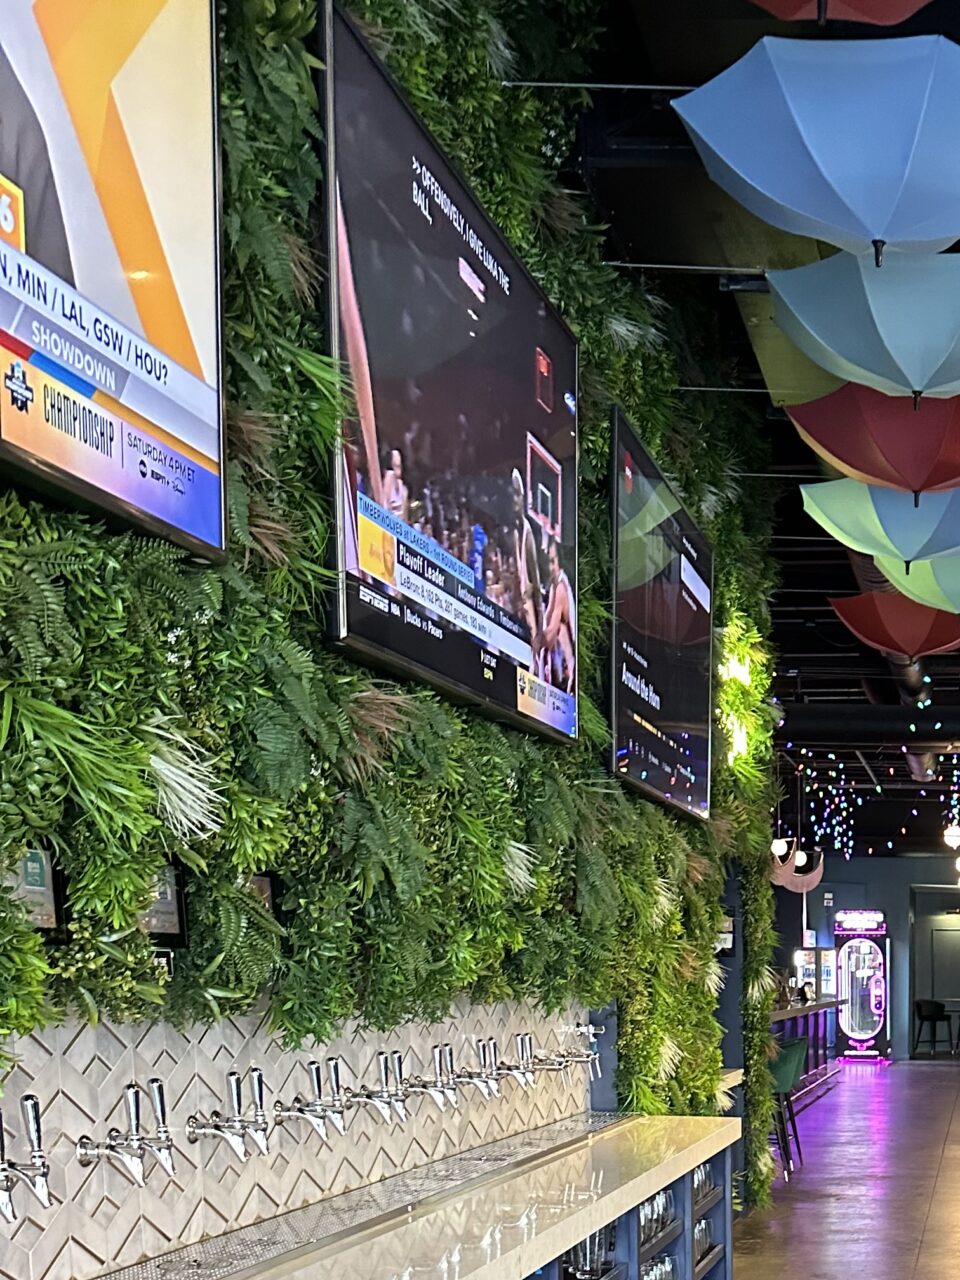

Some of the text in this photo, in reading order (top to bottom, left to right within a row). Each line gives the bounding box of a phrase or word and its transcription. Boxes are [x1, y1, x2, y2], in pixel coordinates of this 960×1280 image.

[412, 181, 432, 226] BALL,
[421, 165, 466, 241] OFFENSIVELY,
[469, 229, 483, 262] GIVE
[483, 247, 499, 281] LUKA
[498, 266, 510, 296] THE
[17, 262, 48, 306] MIN
[62, 293, 90, 338] LAL,
[93, 317, 124, 356] GSW
[135, 344, 168, 386] HOU?
[31, 320, 116, 392] SHOWDOWN
[43, 383, 115, 459] CHAMPIONSHIP
[127, 432, 168, 468] SATURDAY
[168, 456, 174, 471] 4
[175, 460, 187, 479] PM
[187, 467, 196, 483] ET
[358, 497, 403, 537] TIMBERWOLVES
[410, 529, 430, 555] LAKERS
[399, 543, 445, 588] Playoff Leader
[428, 620, 443, 640] Pacers
[621, 662, 661, 711] Around the Horn
